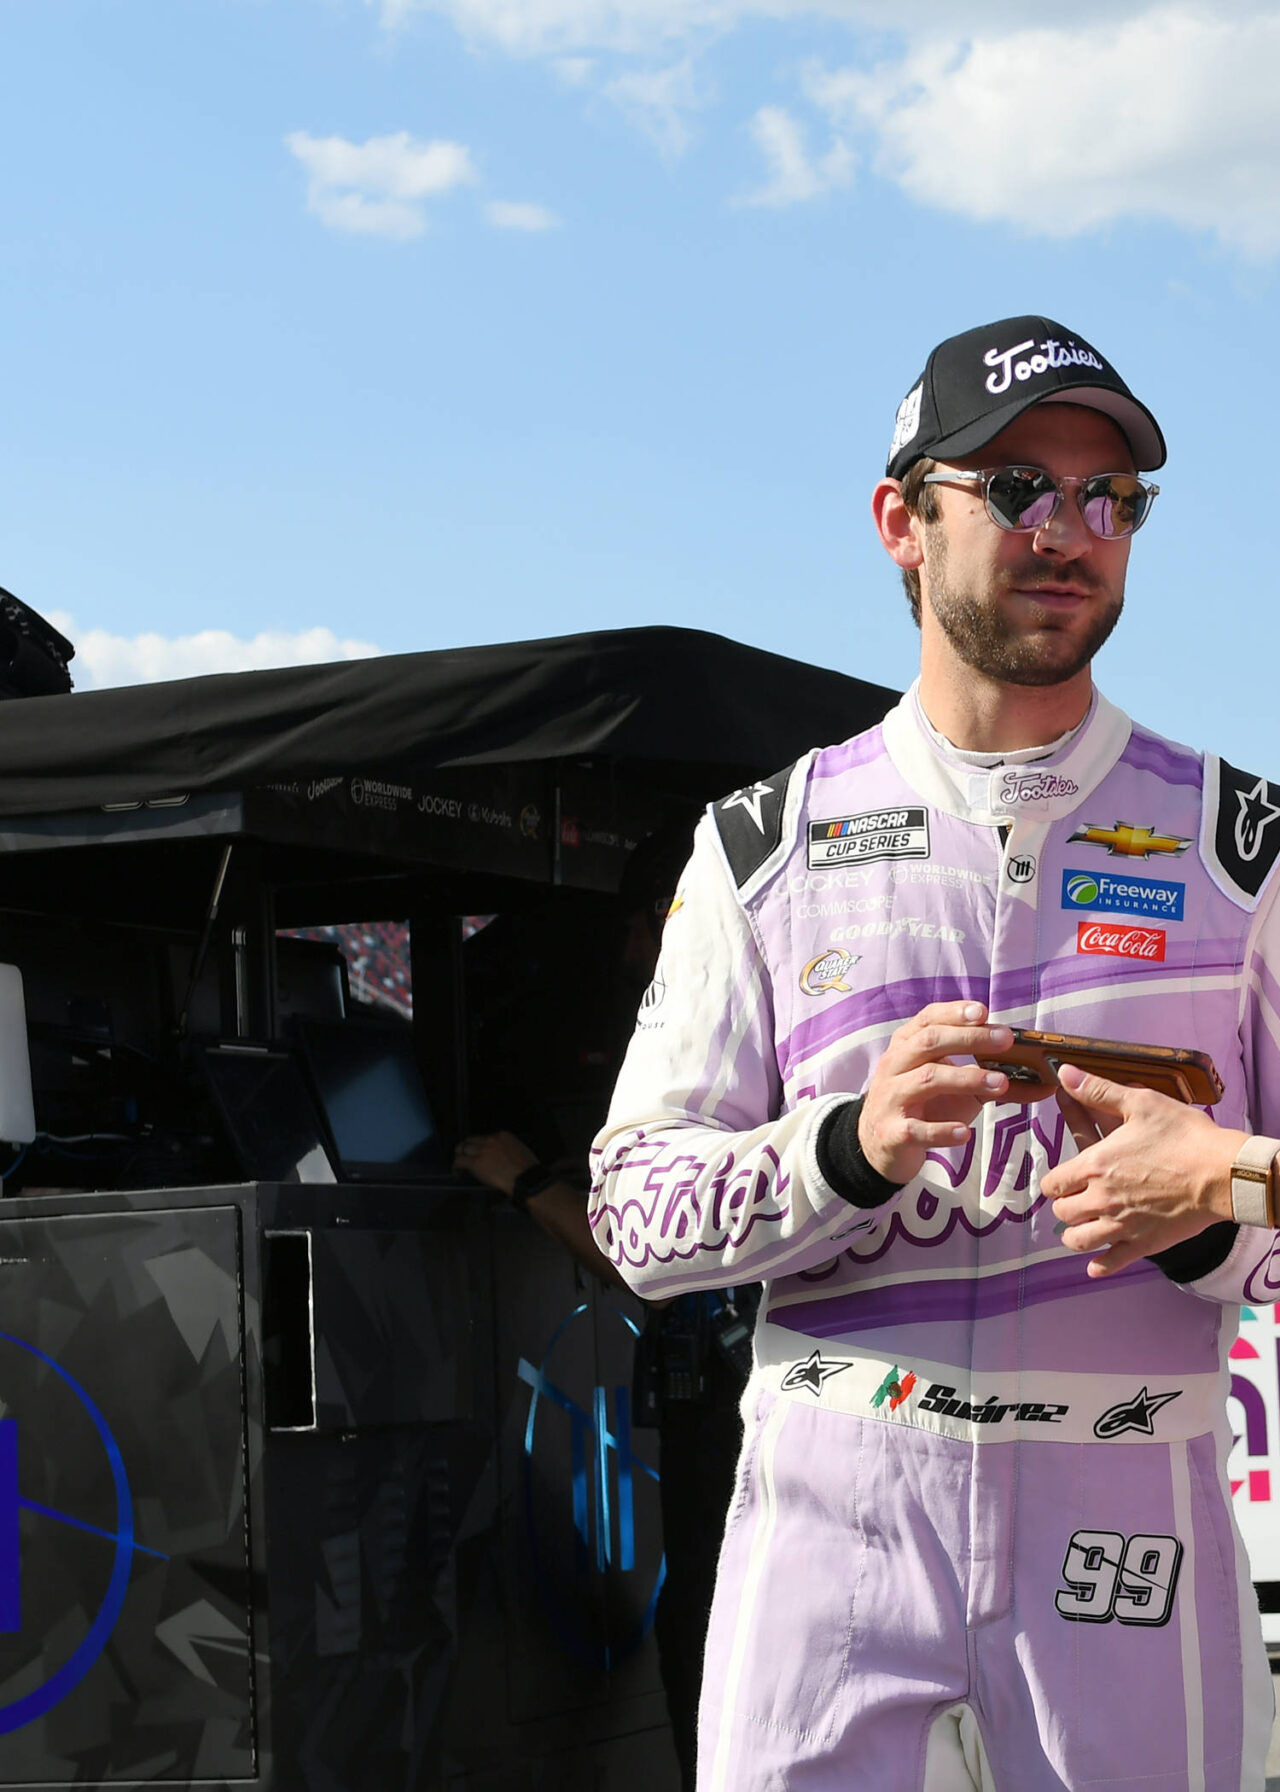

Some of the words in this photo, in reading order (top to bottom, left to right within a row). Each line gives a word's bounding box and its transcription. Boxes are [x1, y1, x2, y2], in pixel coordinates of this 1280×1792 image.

[983, 338, 1103, 395] Tootsies
[363, 778, 413, 801] WORLDWIDE
[1000, 771, 1079, 805] Tootsies
[364, 793, 397, 811] EXPRESS
[417, 795, 462, 819] JOCKEY
[847, 811, 909, 835] NASCAR
[826, 842, 857, 858] CUP
[858, 833, 911, 853] SERIES
[775, 869, 875, 897] JOCKEY
[909, 863, 992, 887] WORLDWIDE
[910, 874, 964, 889] EXPRESS
[1099, 878, 1178, 906] Freeway
[797, 895, 894, 919] COMMSCOPE
[1099, 897, 1176, 913] INSURANCE
[829, 917, 967, 944] GOODYEAR
[1080, 926, 1163, 957] Coca-Cola
[814, 955, 859, 972] QUAKER
[819, 965, 849, 980] STATE
[917, 1383, 1070, 1424] Suárez
[1055, 1530, 1184, 1628] 99
